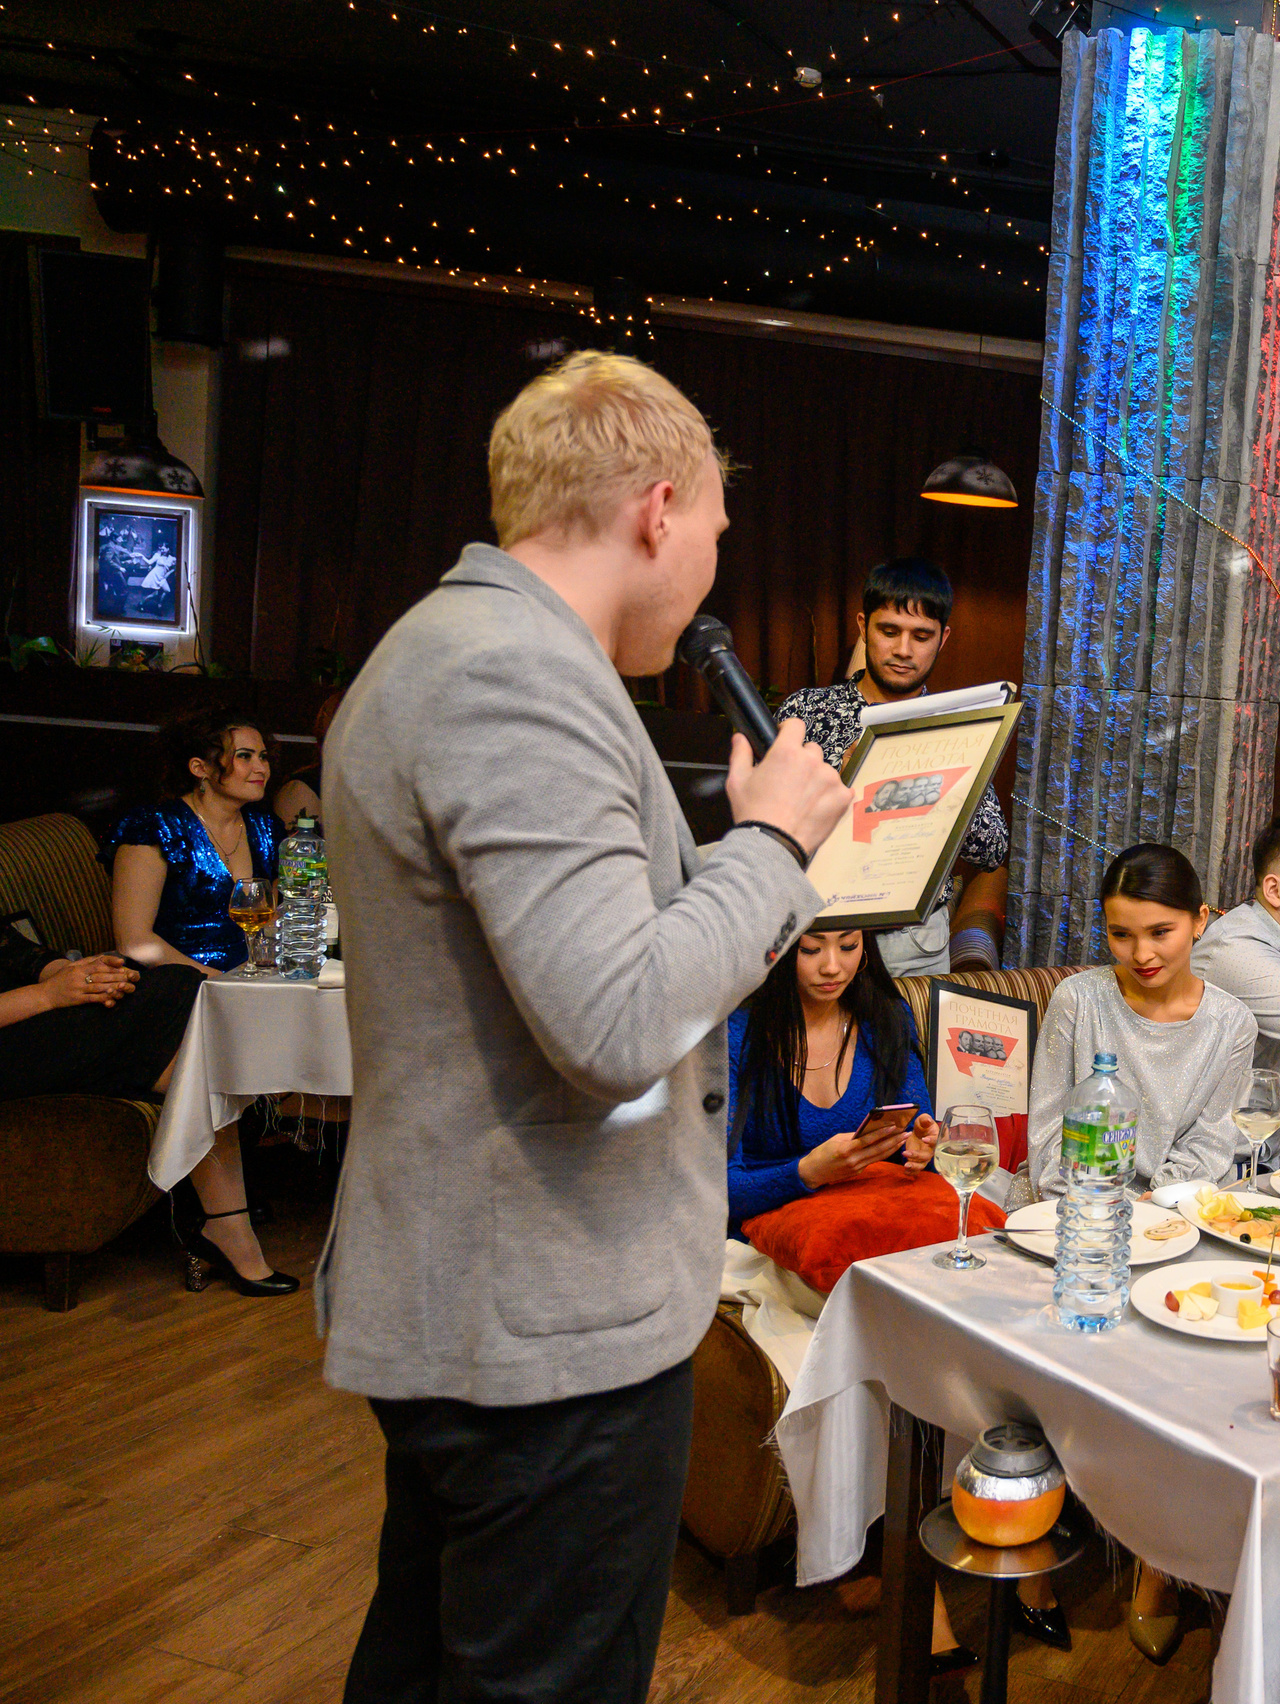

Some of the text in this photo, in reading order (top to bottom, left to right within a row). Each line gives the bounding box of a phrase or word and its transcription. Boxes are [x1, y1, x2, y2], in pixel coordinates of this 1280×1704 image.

[881, 733, 985, 760] ПОЧЕТНАЯ
[882, 752, 966, 775] ГРАМОТА
[949, 1001, 1018, 1025] ПОЧЕТНАЯ
[955, 1014, 1013, 1036] ГРАМОТА
